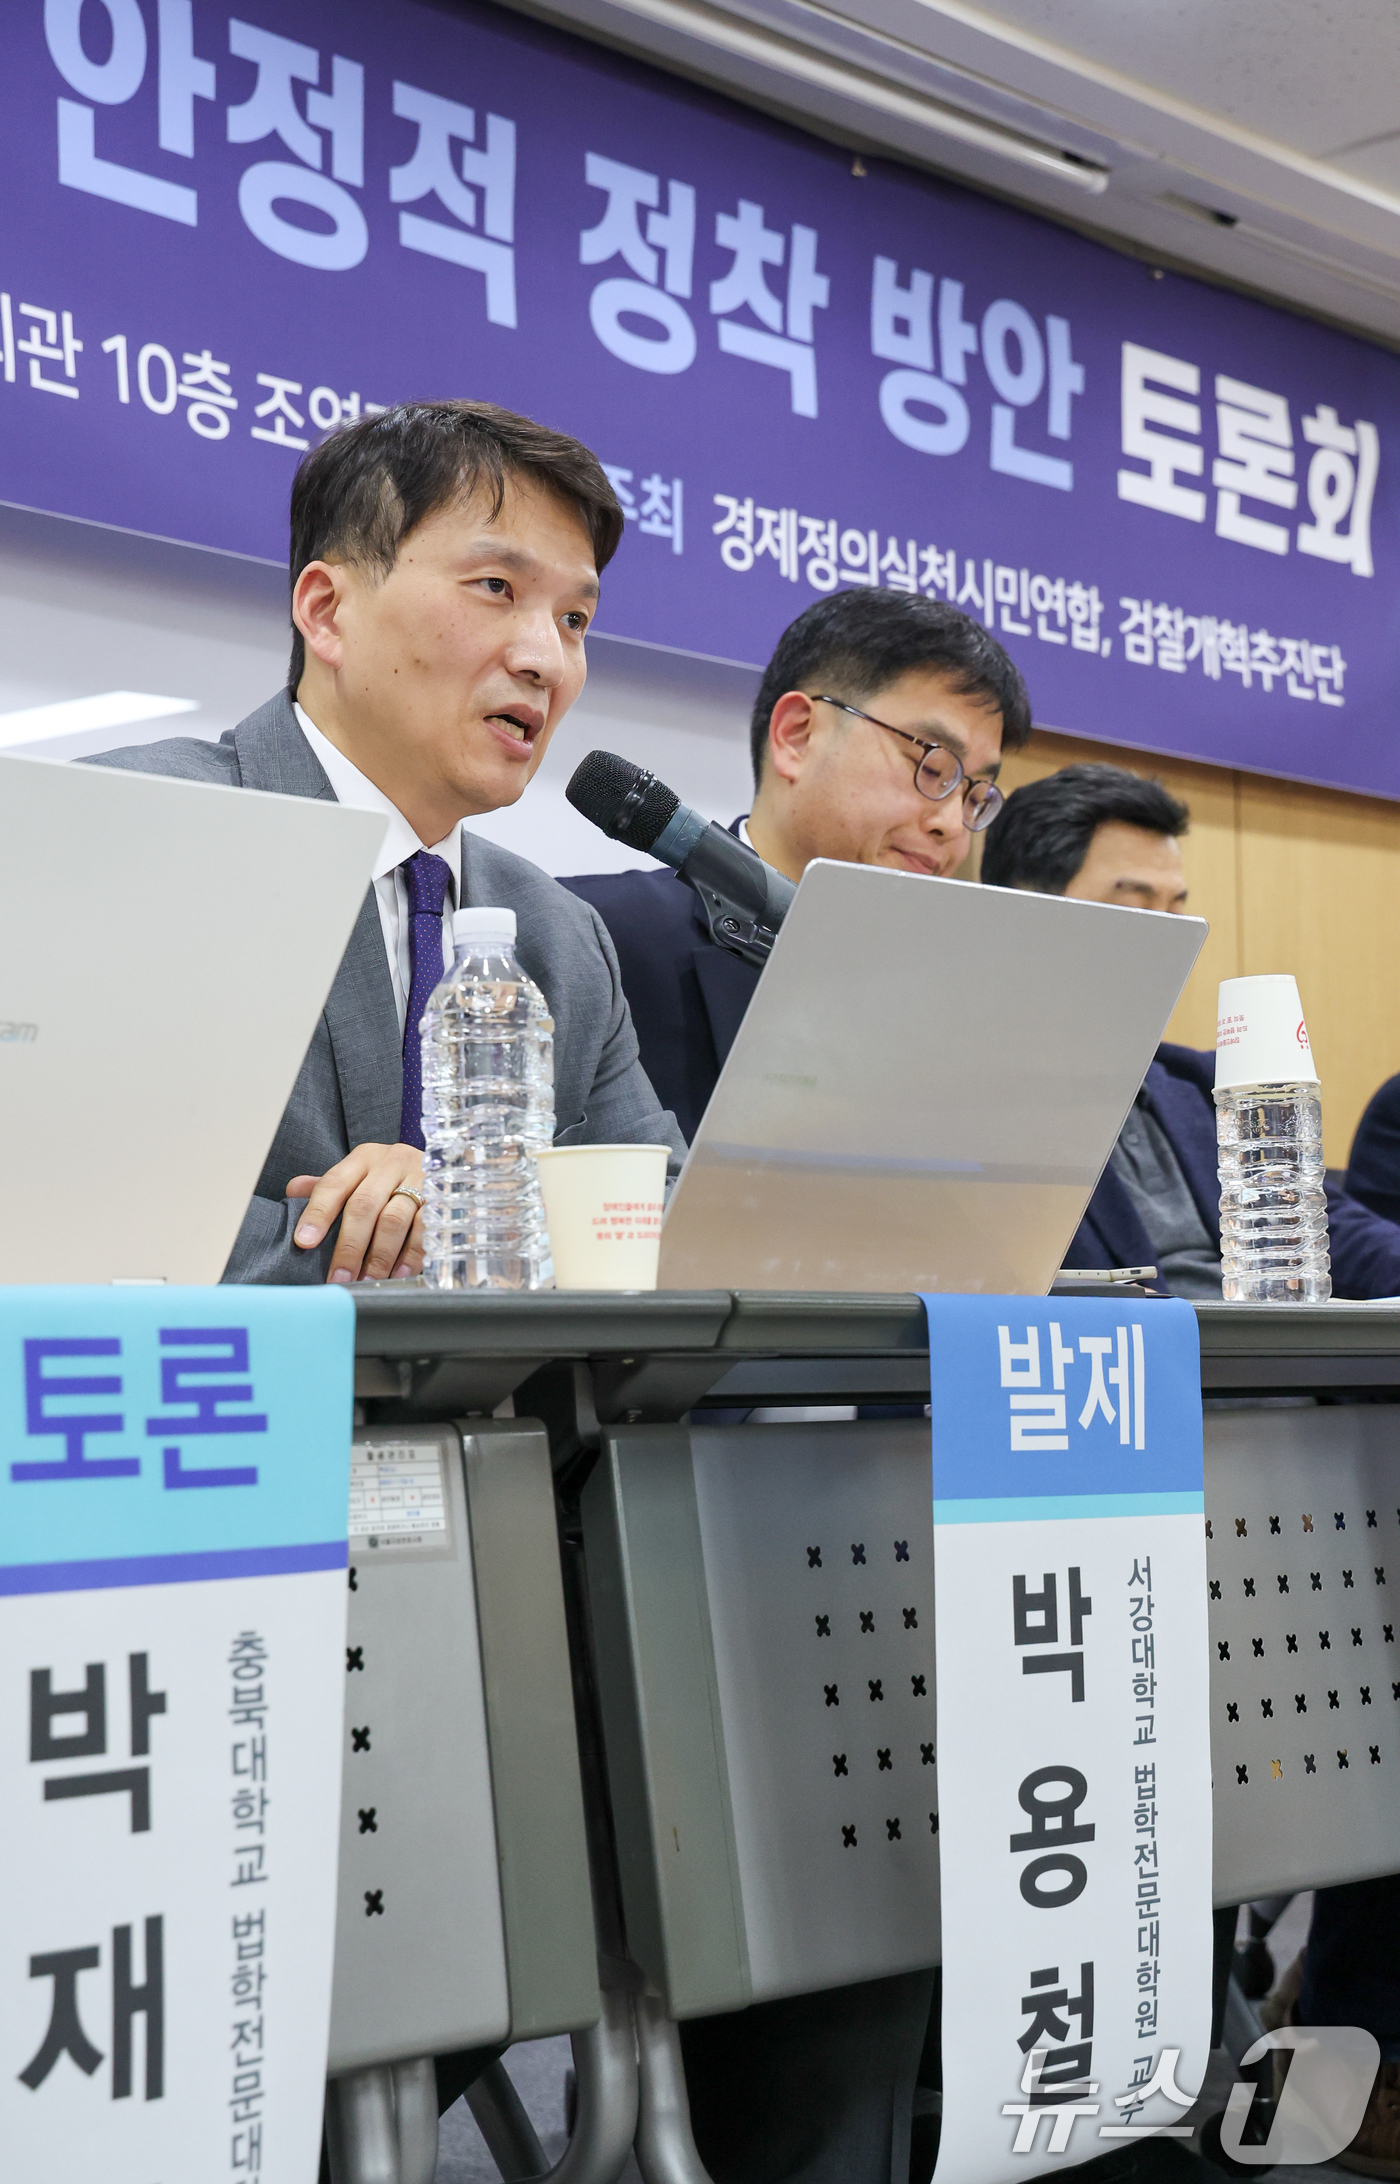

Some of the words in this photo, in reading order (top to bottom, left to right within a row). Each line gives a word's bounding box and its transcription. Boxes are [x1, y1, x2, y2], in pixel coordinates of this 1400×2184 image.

[44, 0, 517, 329] 안정적
[580, 153, 830, 419] 정착
[871, 256, 1085, 492] 방안
[1116, 342, 1381, 578] 토론회
[101, 334, 239, 441] 10층
[1119, 596, 1348, 708] 검찰개혁추진단
[10, 1328, 268, 1490] 토론
[998, 1321, 1147, 1451] 발제
[228, 1631, 269, 1887] 충북대학교
[1127, 1556, 1157, 1746] 서강대학교
[17, 1651, 167, 2184] 박재
[1133, 1762, 1161, 2039] 법학전문대학원
[229, 1907, 267, 2184] 법학전문대
